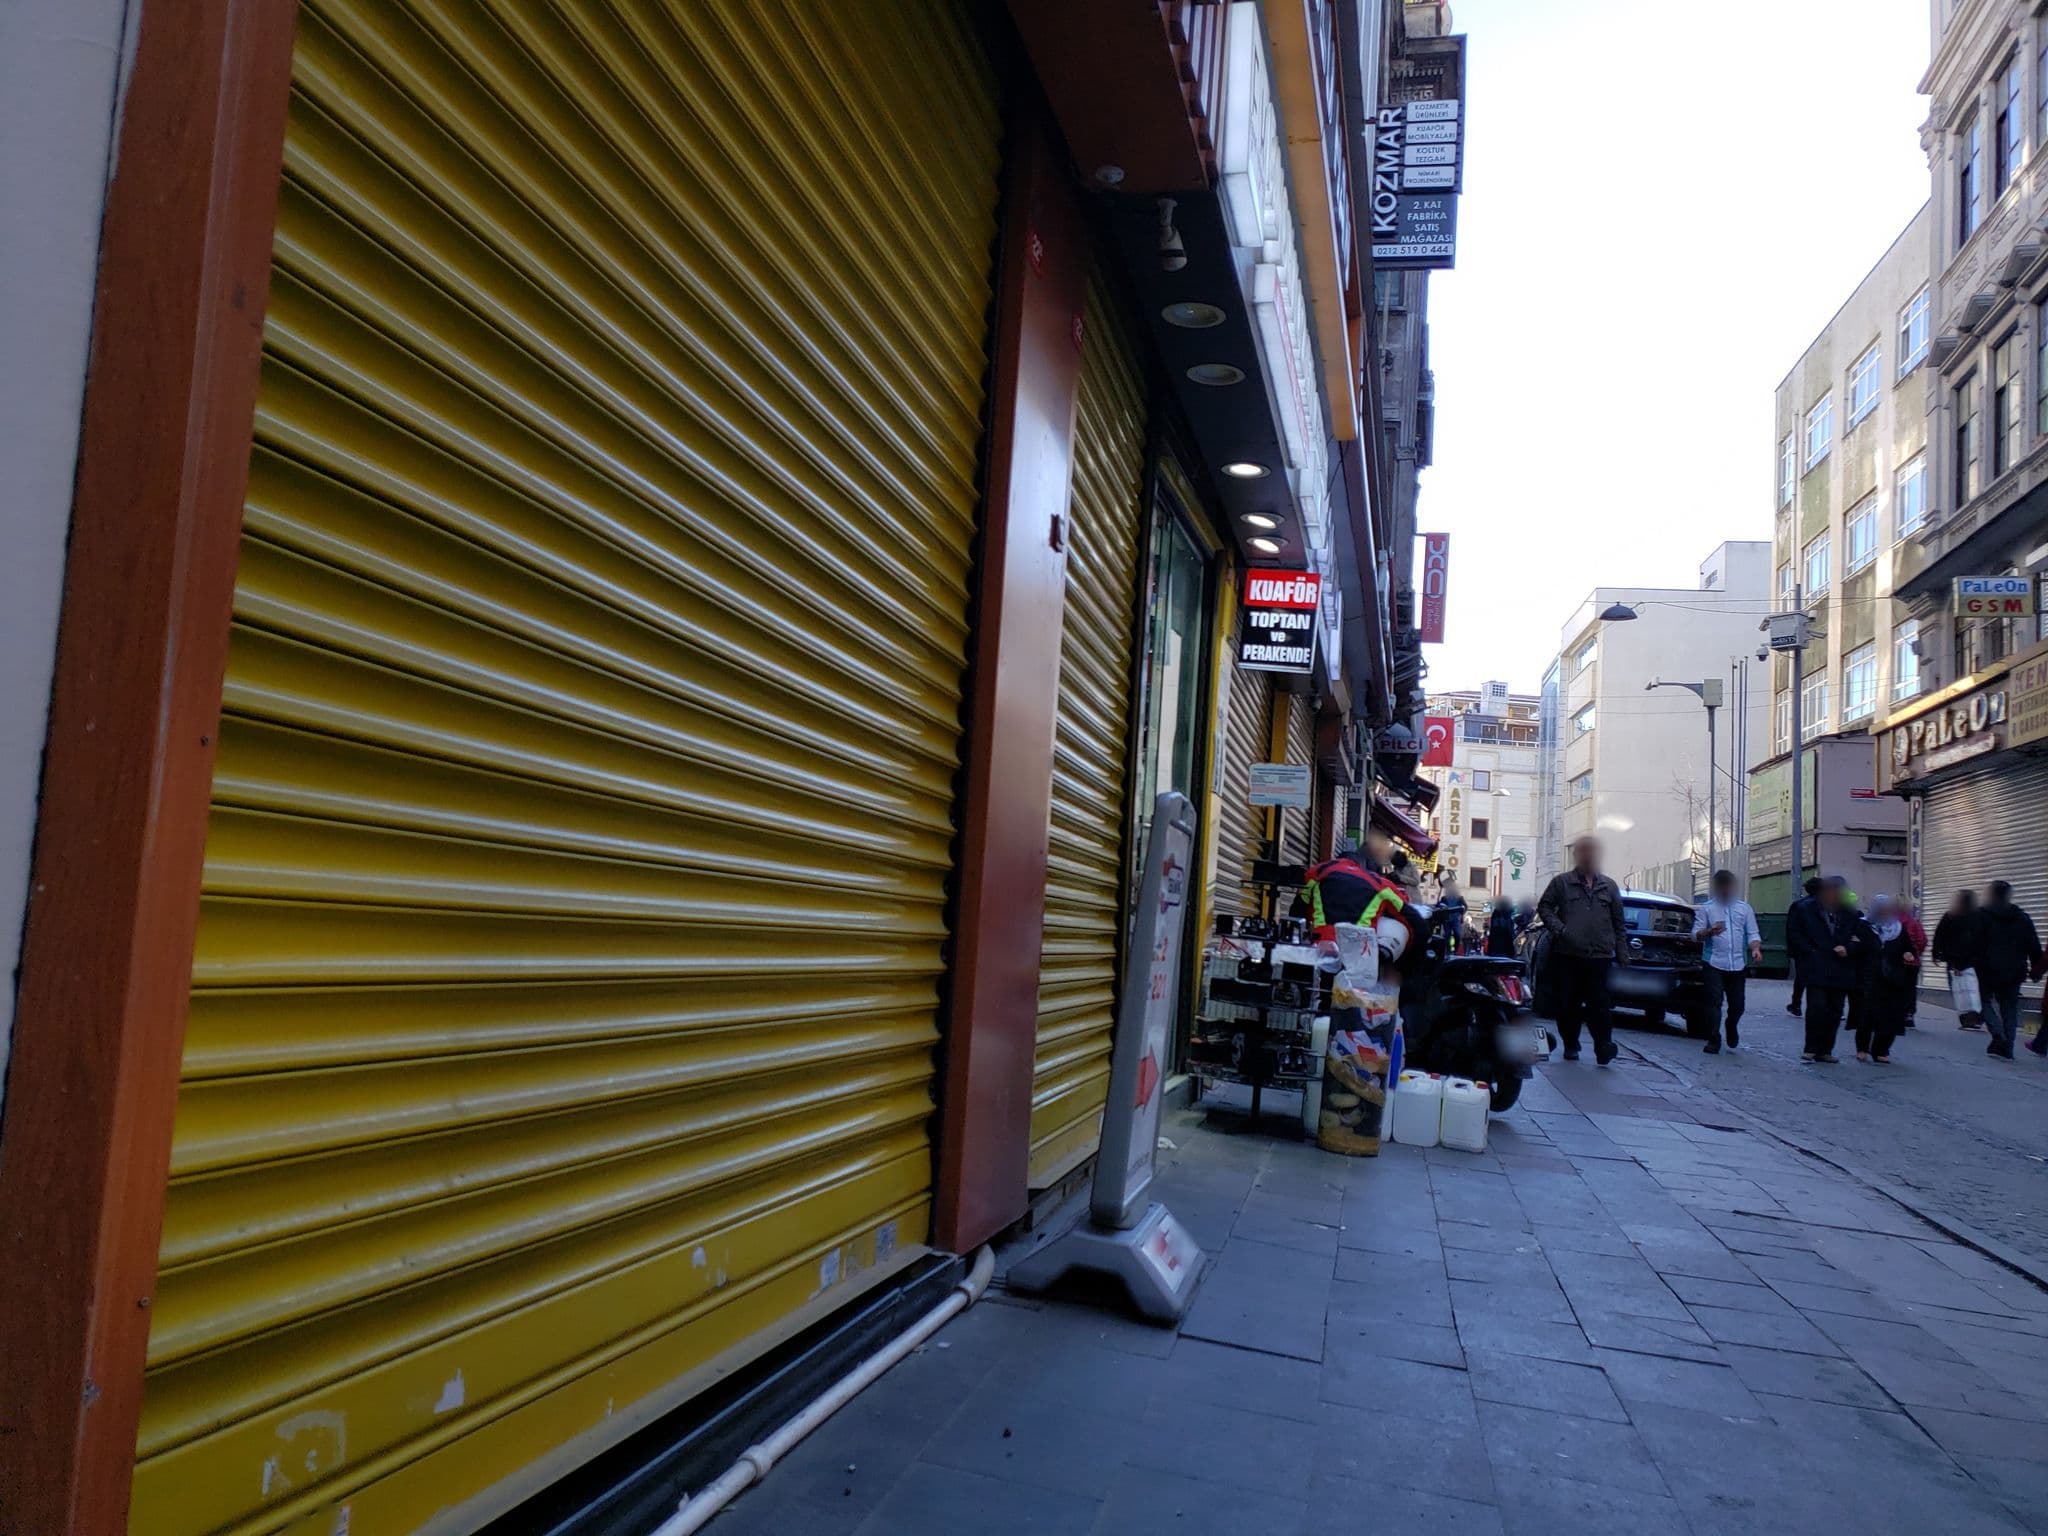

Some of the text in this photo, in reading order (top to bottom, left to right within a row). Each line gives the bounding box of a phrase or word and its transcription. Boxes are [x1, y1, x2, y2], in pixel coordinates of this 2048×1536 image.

[1373, 107, 1402, 232] KOZMAR
[1413, 201, 1442, 210] 2. KAT
[1407, 212, 1447, 221] FABRİKA
[1414, 223, 1440, 233] SATIŞ
[1400, 234, 1454, 244] MAĞAZASI
[1377, 245, 1449, 255] 0212 519 0 444
[1249, 576, 1318, 603] KUAFÖR
[1962, 580, 2029, 593] PaLeOn
[1249, 611, 1311, 630] TOPTAN
[1270, 631, 1286, 642] ve
[1242, 644, 1311, 663] PERAKENDE
[1449, 787, 1461, 836] ARZU
